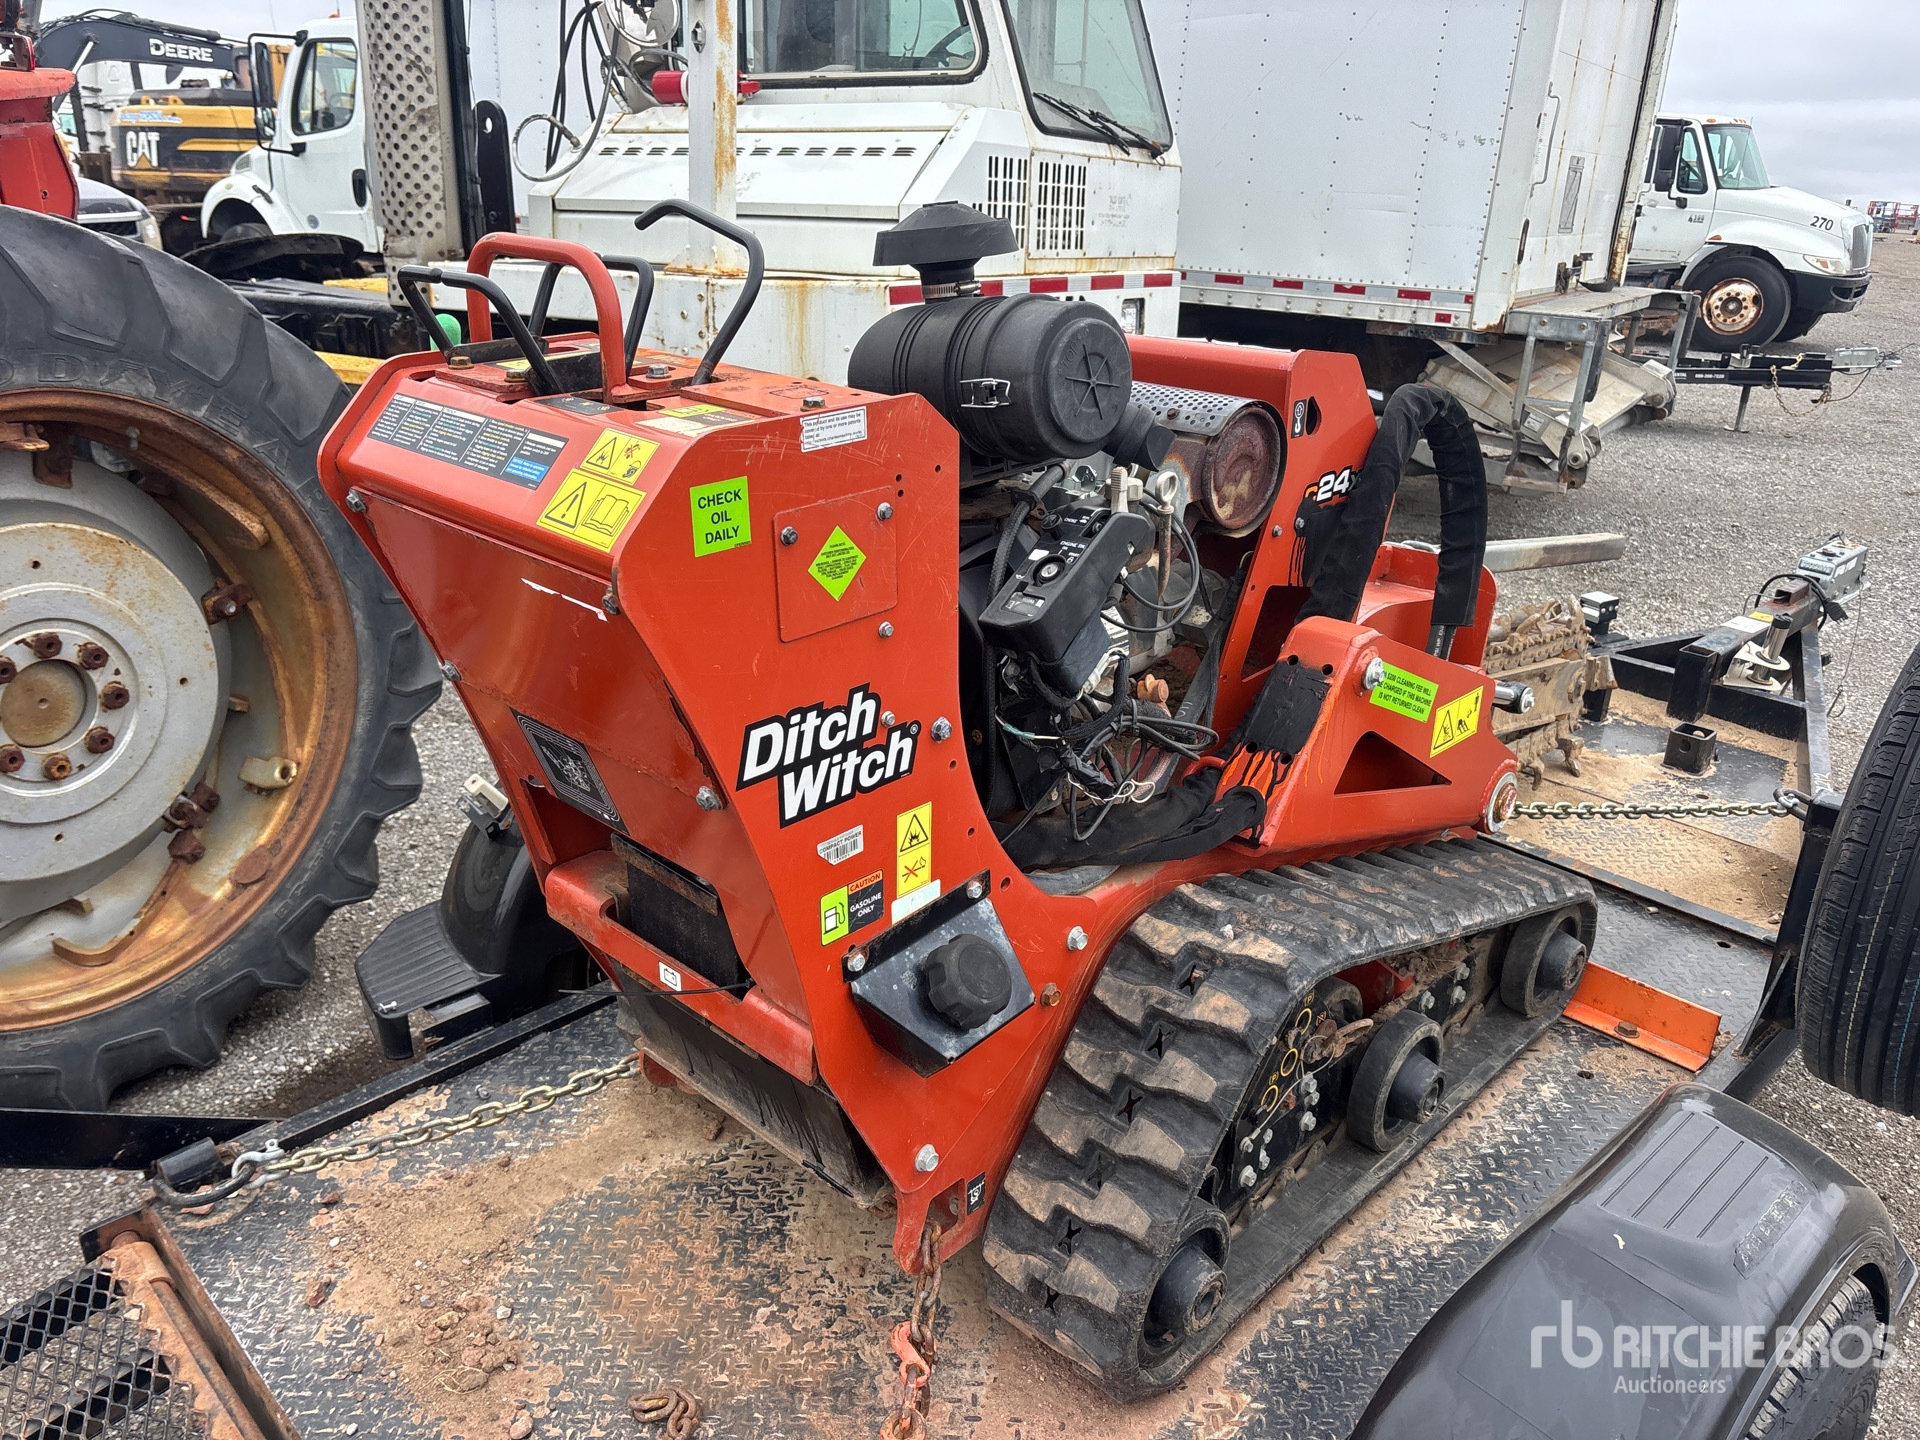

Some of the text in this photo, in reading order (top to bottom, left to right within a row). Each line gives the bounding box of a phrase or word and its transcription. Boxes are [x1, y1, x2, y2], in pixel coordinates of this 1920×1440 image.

[149, 38, 213, 62] DEERE
[126, 131, 160, 167] CAT
[1810, 216, 1834, 231] 270
[698, 489, 742, 509] CHECK
[711, 510, 732, 524] OIL
[705, 526, 740, 544] DAILY
[1383, 682, 1402, 696] CHARGED
[1414, 694, 1432, 706] MACHINE
[1396, 676, 1416, 690] CLEANING
[1422, 686, 1432, 696] WILL
[1383, 693, 1392, 702] NOT
[1392, 696, 1412, 710] RETURNED
[1412, 703, 1425, 714] CLEAN
[743, 691, 876, 782] Ditch
[820, 839, 843, 854] COMPACT
[844, 830, 862, 842] POWER
[850, 873, 881, 892] CAUTION
[850, 892, 882, 912] GASOLINE
[858, 904, 874, 917] ONLY
